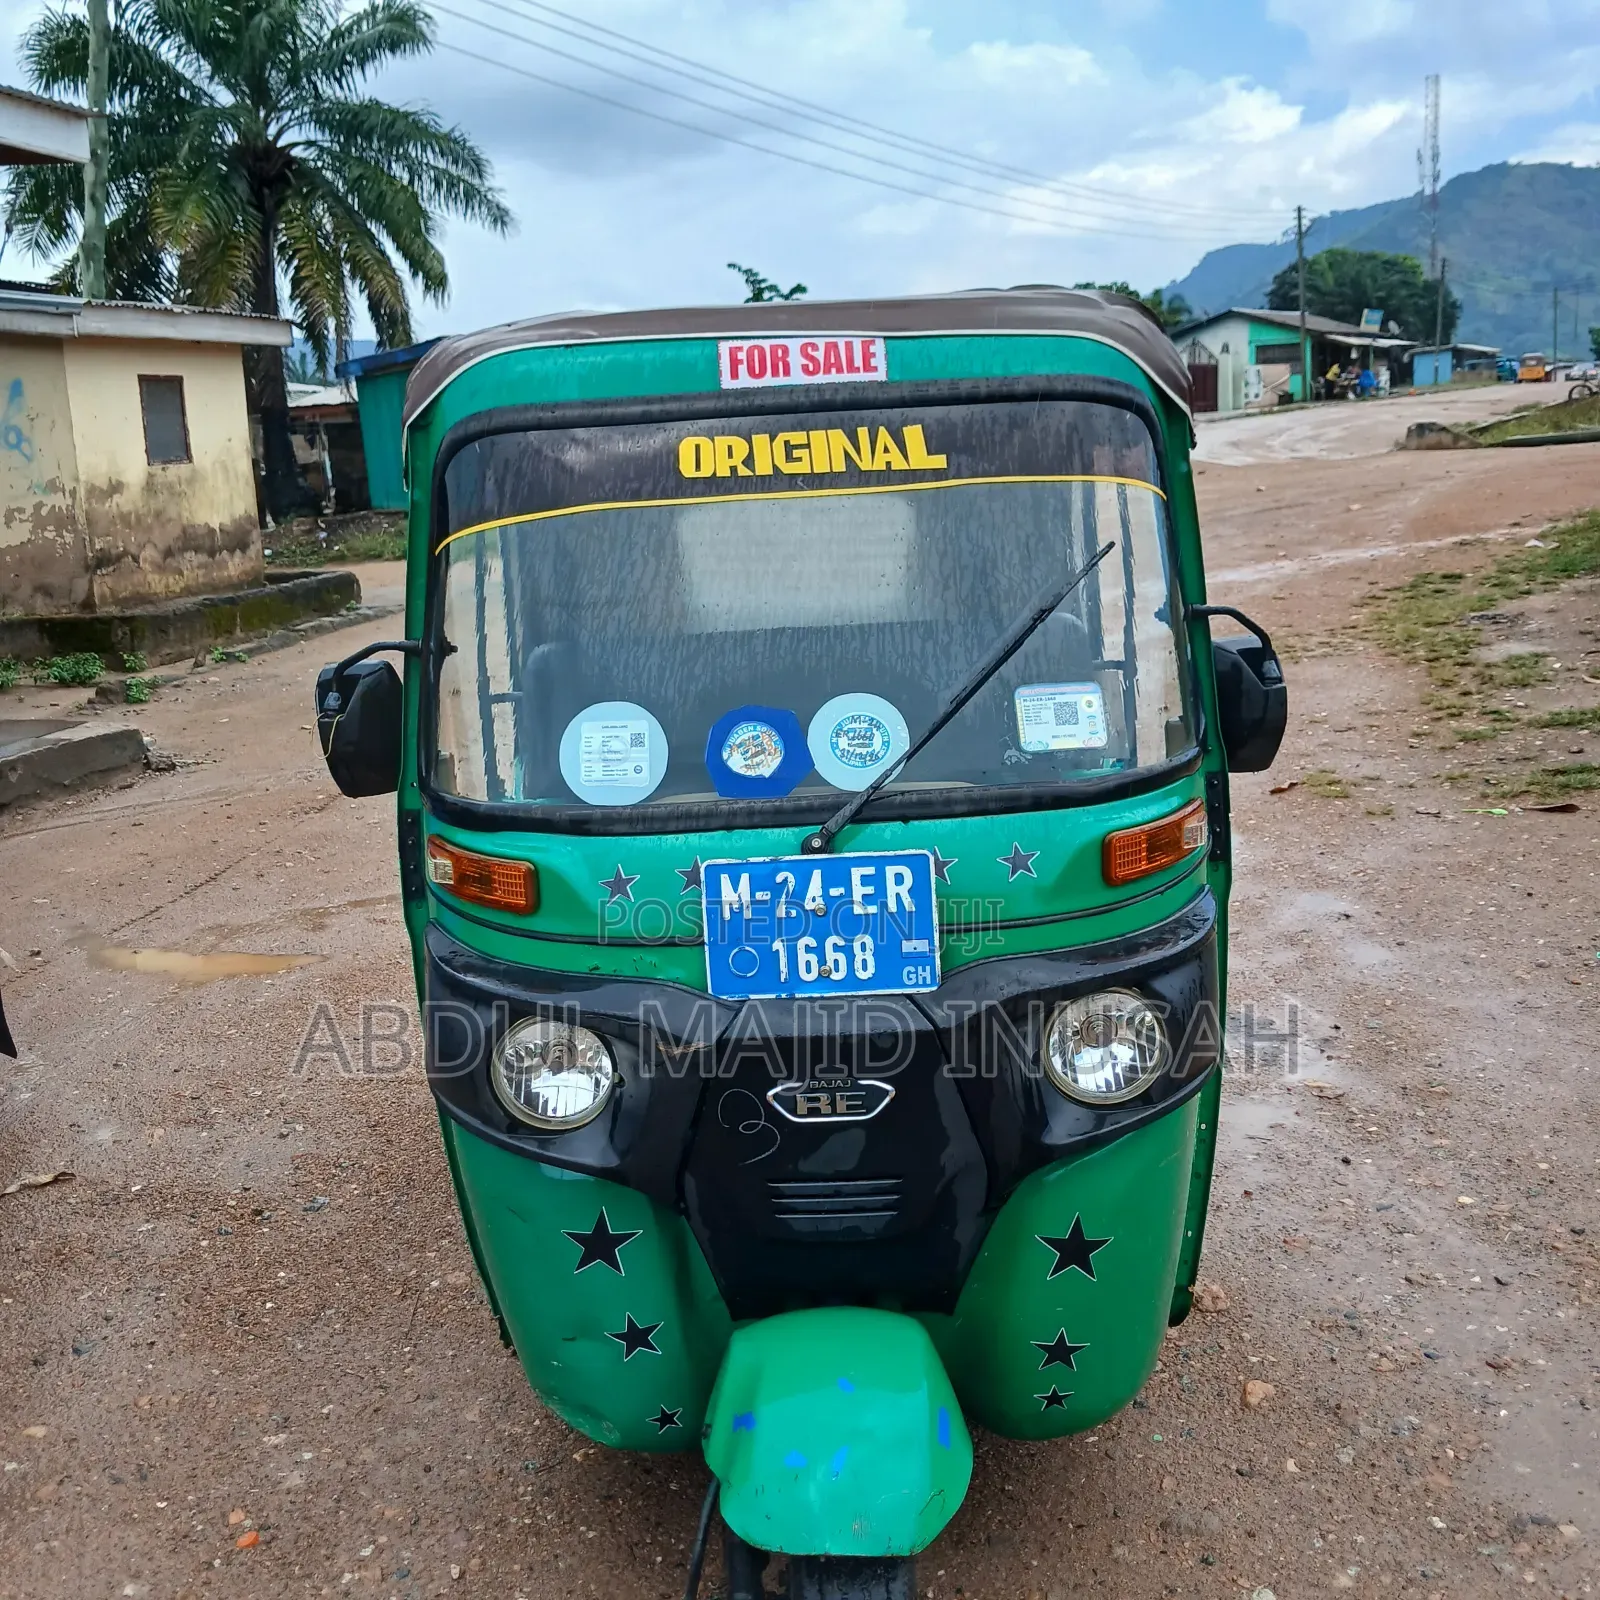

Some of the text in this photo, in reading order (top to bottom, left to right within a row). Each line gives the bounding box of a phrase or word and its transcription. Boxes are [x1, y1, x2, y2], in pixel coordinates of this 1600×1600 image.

[729, 339, 879, 381] FOR SALE
[678, 424, 948, 478] ORIGINAL
[720, 865, 916, 921] M-24-ER
[772, 934, 876, 983] 1668
[902, 965, 931, 985] GH
[796, 1091, 867, 1115] RE
[809, 1080, 851, 1089] BAJAJ
